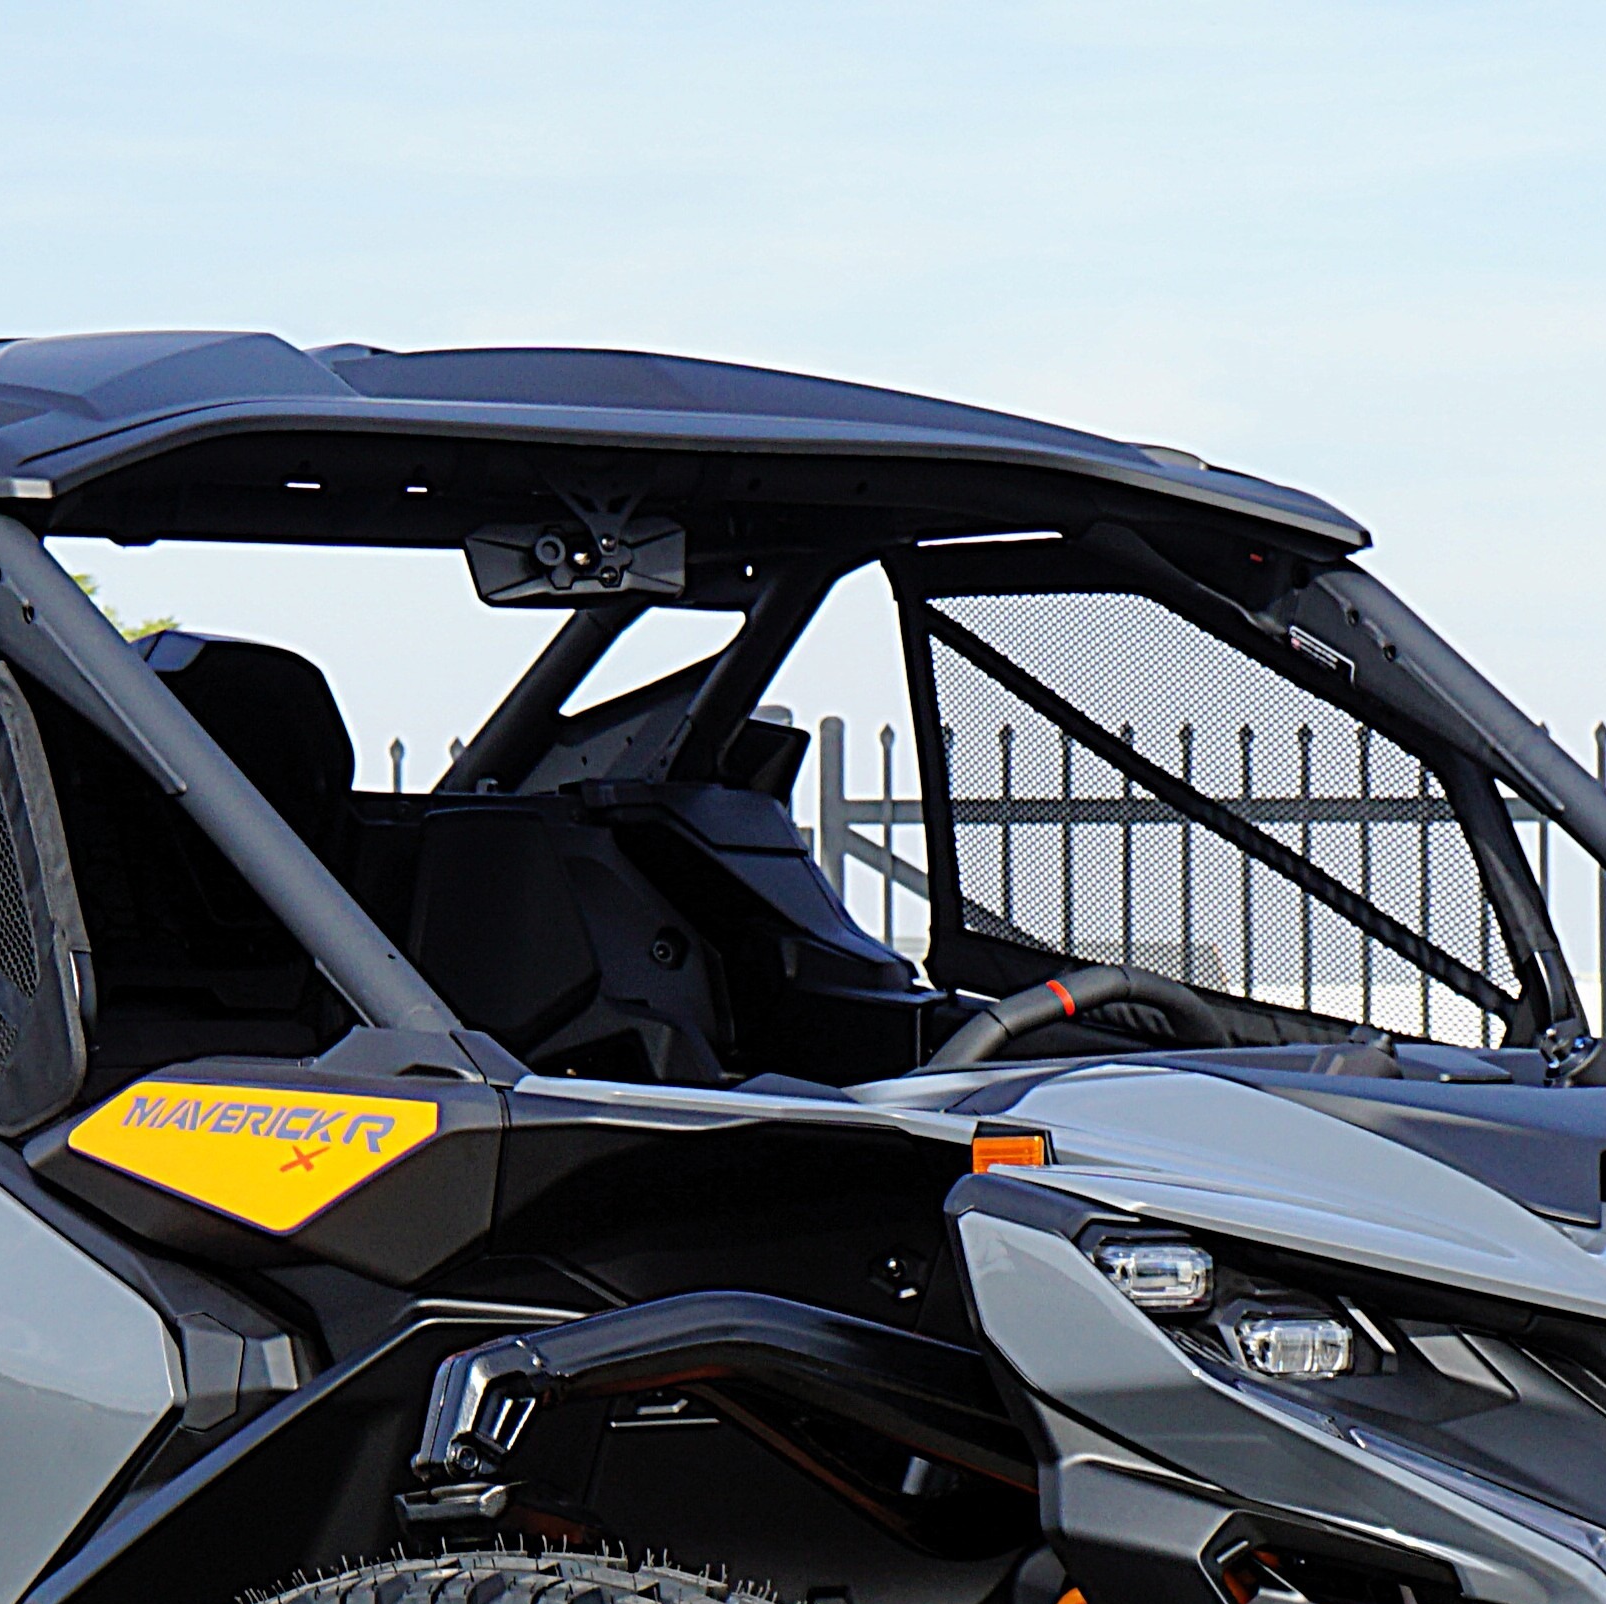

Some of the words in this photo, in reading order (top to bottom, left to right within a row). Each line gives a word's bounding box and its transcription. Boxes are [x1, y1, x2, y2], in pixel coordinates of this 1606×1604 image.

[121, 1095, 346, 1143] MAVERICK
[343, 1114, 396, 1154] R
[279, 1145, 332, 1173] X
